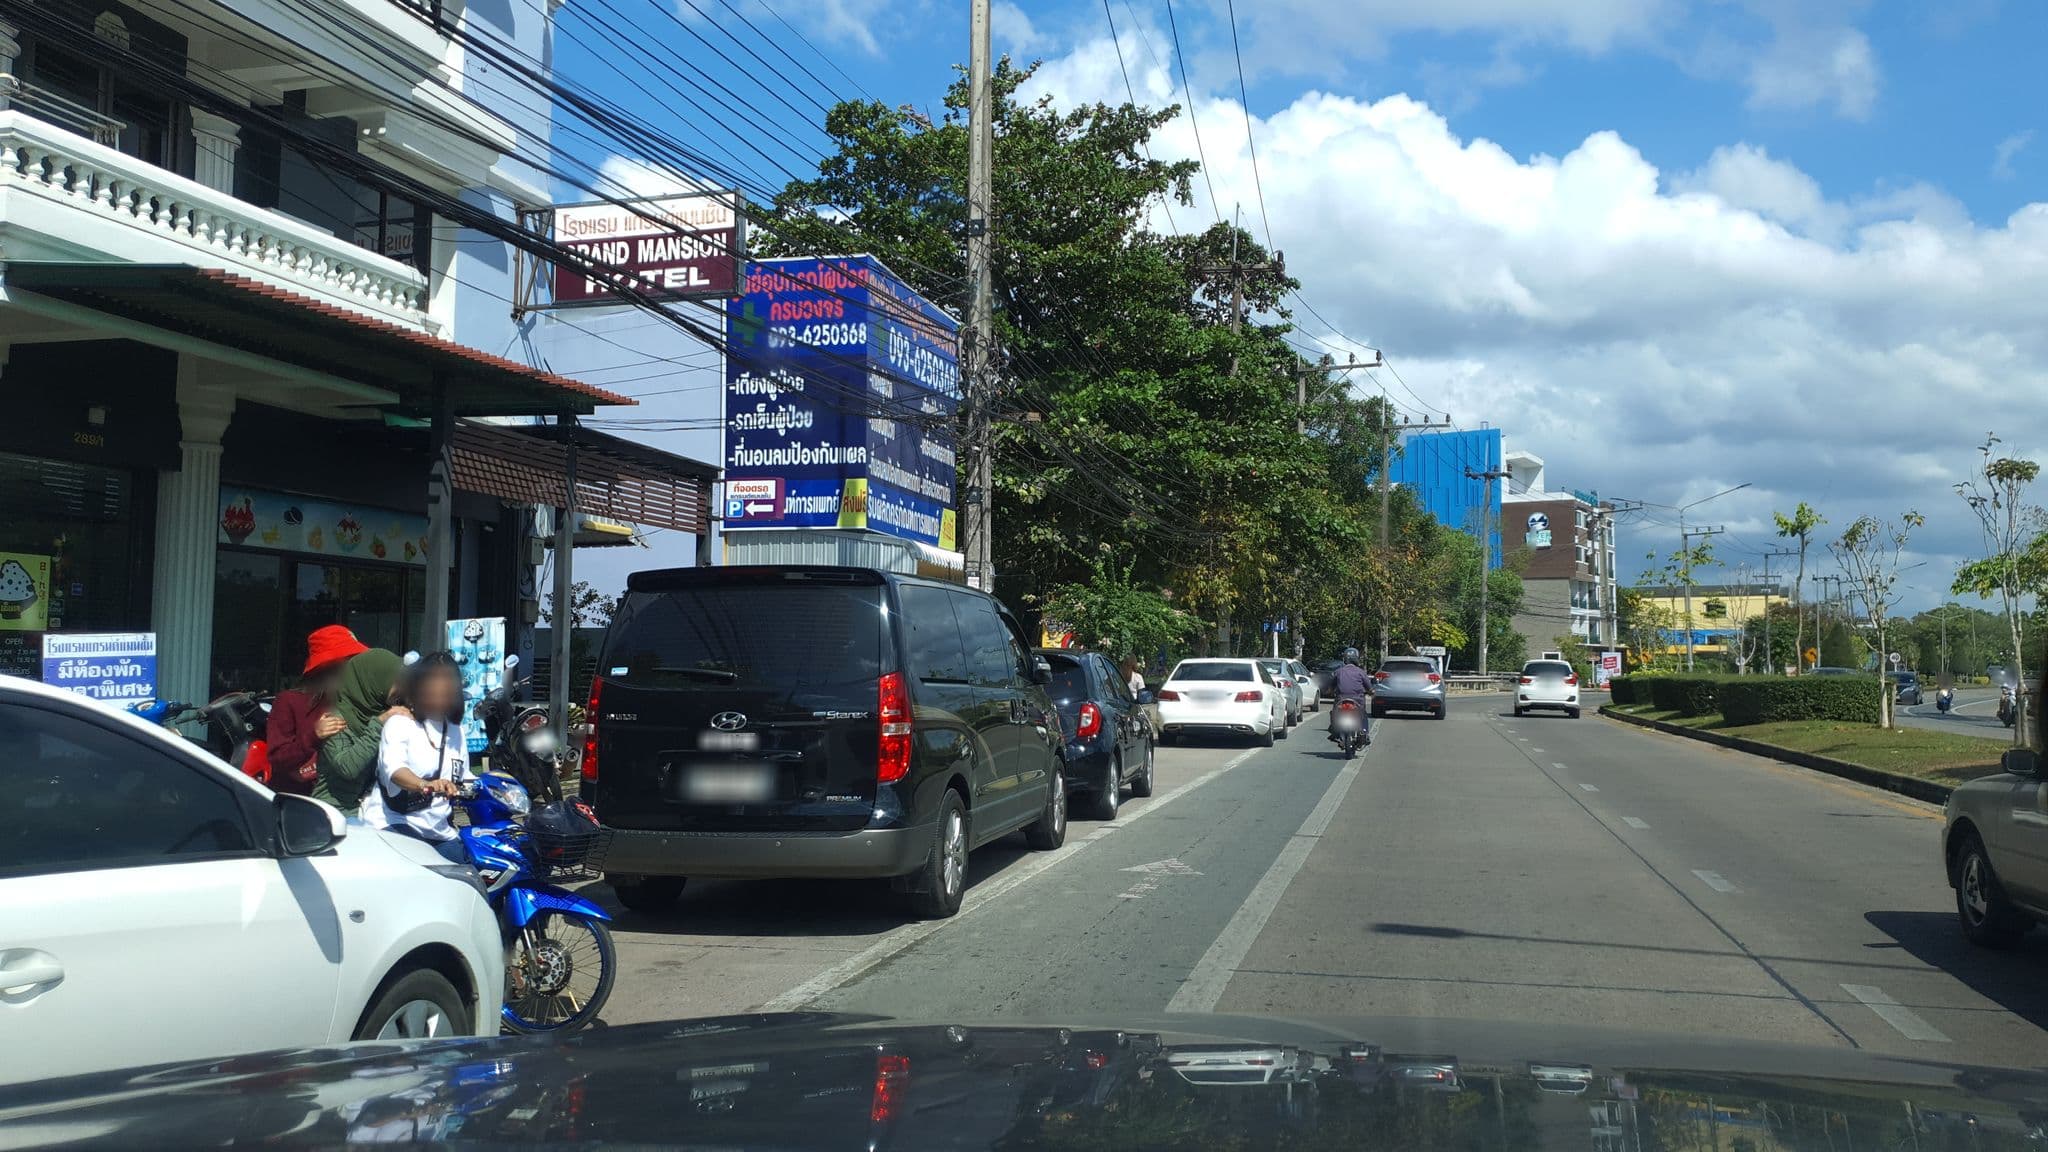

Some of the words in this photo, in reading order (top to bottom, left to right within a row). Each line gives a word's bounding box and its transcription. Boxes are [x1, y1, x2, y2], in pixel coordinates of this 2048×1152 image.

[563, 214, 617, 236] โรงแรม
[637, 232, 727, 263] MANSION
[770, 299, 844, 321] ครบวงจร
[768, 322, 867, 348] 093-6250368
[728, 437, 867, 467] -ที่นอนลมป้องกันแผล
[58, 659, 141, 678] มีห้องพัก
[825, 710, 869, 720] Starex
